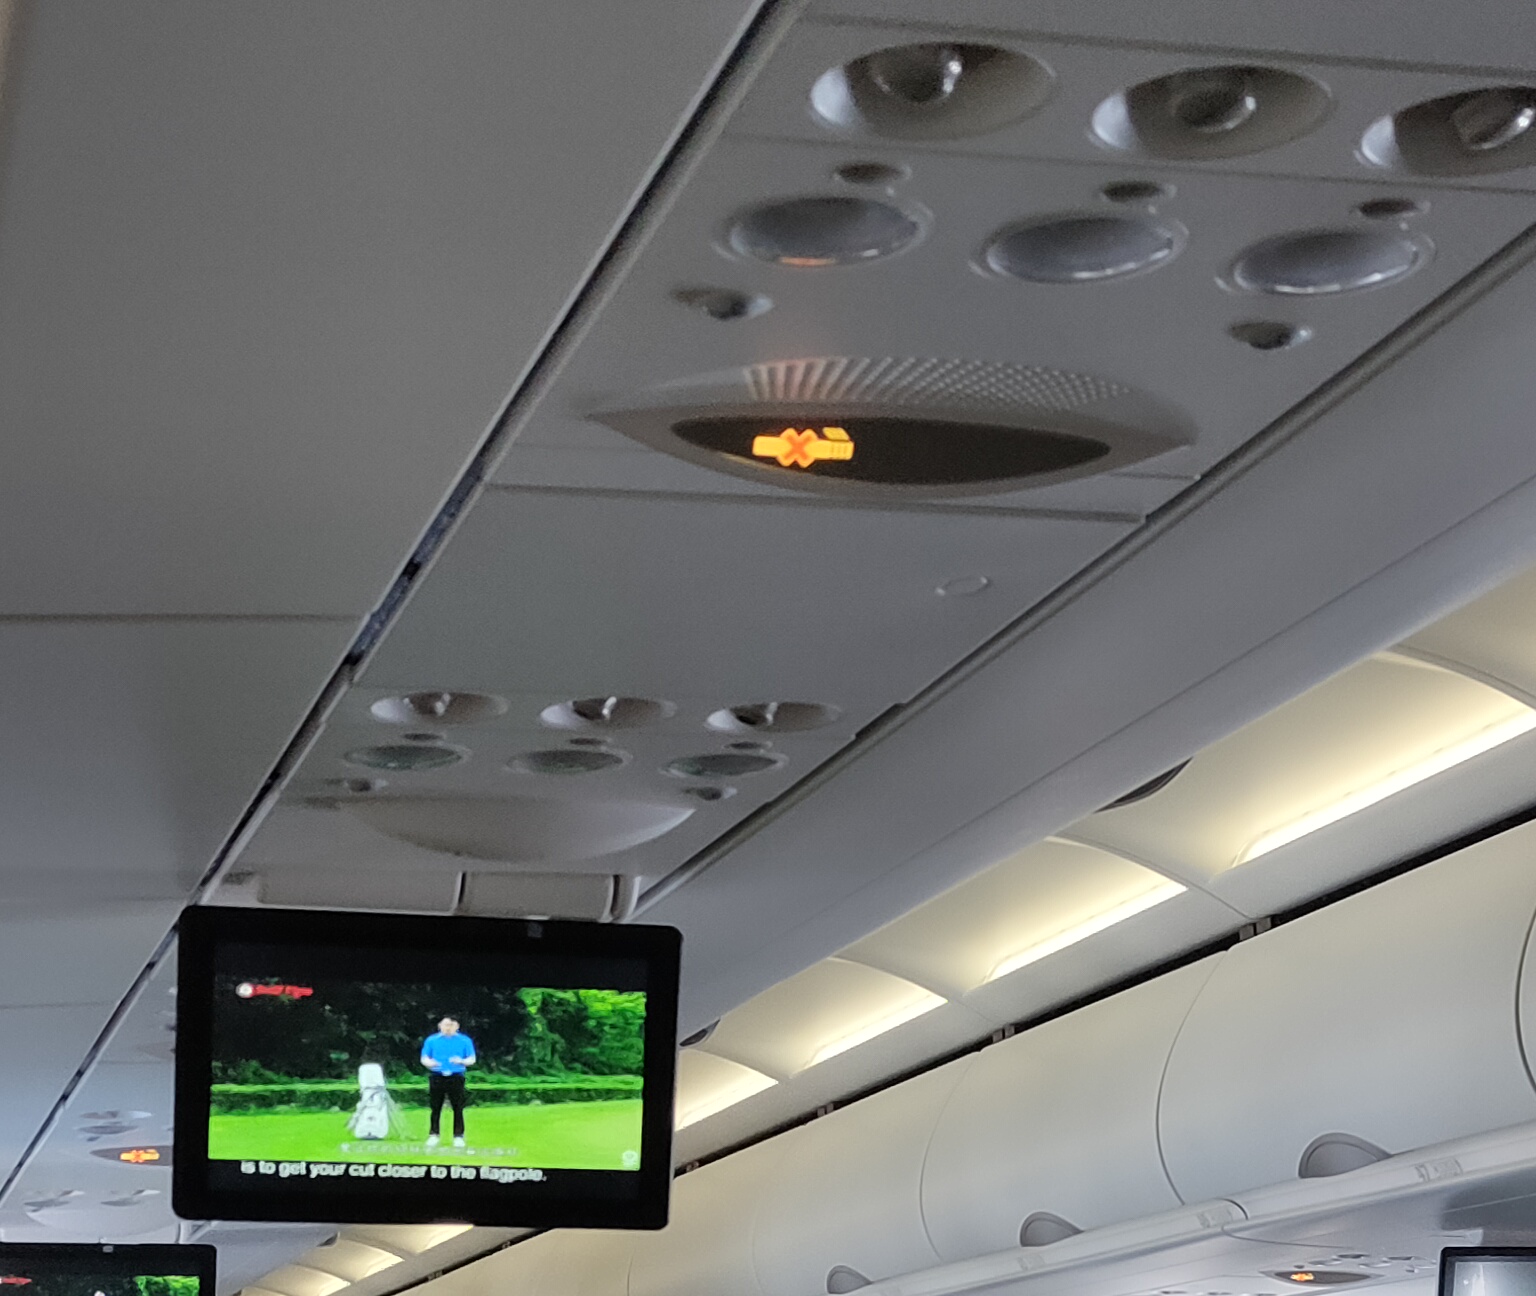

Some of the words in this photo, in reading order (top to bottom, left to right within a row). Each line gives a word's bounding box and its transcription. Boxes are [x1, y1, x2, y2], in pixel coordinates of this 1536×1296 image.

[240, 1161, 256, 1174] is
[259, 1161, 276, 1175] to
[279, 1161, 306, 1178] get
[310, 1162, 346, 1178] your
[349, 1163, 376, 1177] cut
[378, 1163, 426, 1178] closer
[431, 1164, 448, 1178] to
[450, 1165, 476, 1179] the
[479, 1165, 547, 1183] flagpole.
